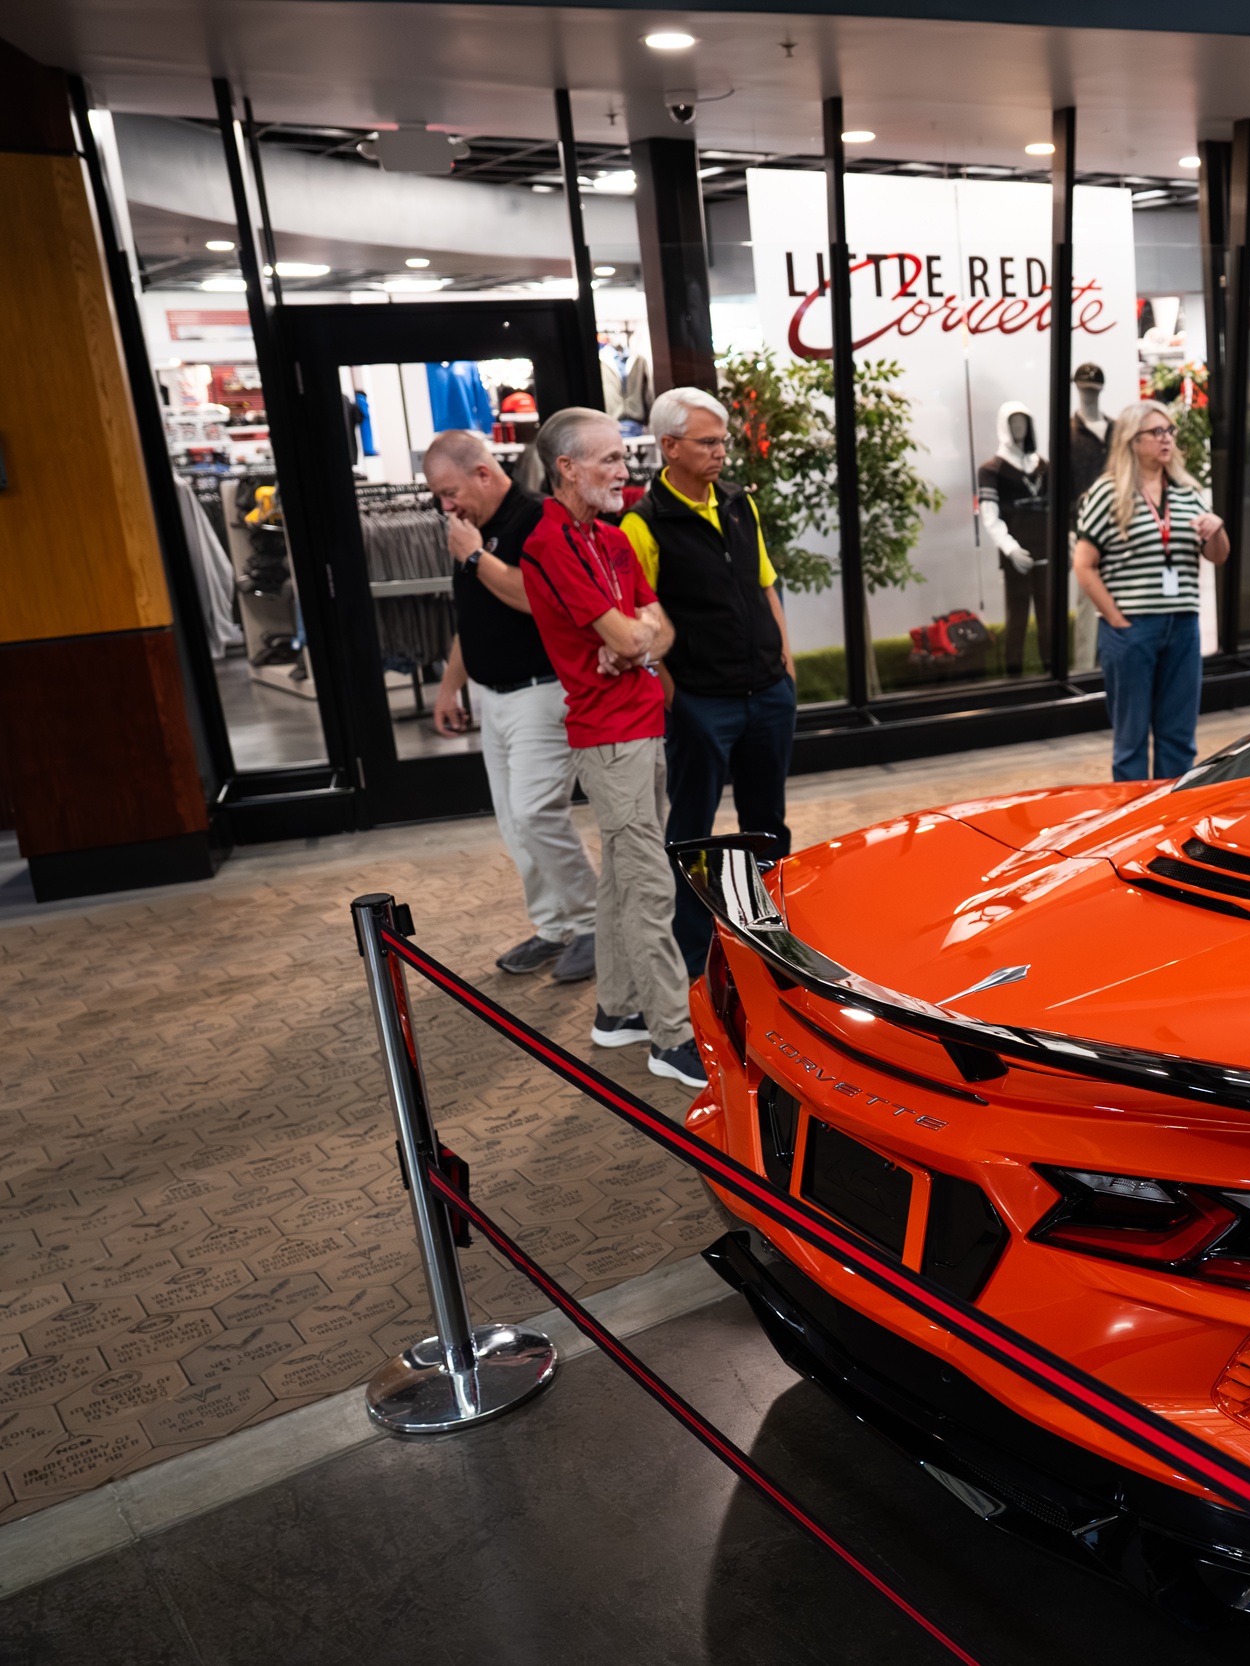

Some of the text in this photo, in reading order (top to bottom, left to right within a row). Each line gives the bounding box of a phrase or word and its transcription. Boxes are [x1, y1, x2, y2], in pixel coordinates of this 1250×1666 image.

[785, 251, 1047, 298] LITLE RED
[766, 1031, 949, 1131] CORVETTE
[53, 1438, 91, 1454] NCM
